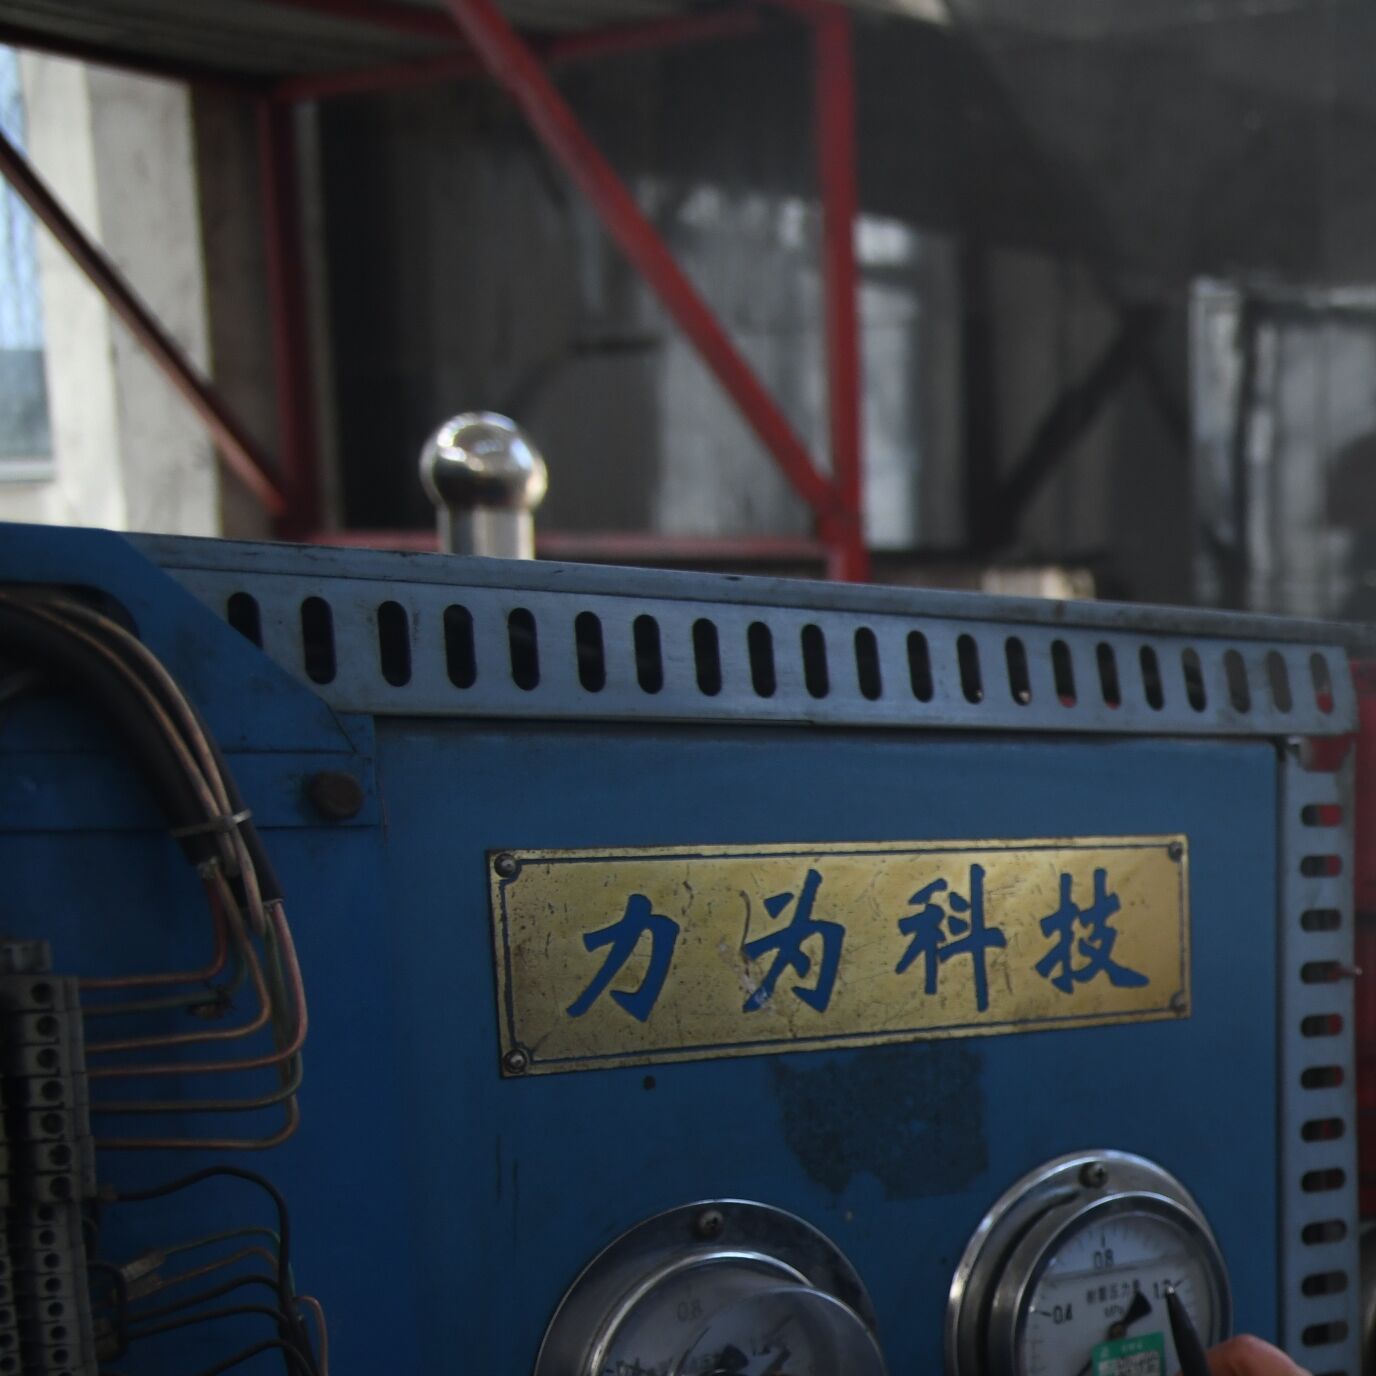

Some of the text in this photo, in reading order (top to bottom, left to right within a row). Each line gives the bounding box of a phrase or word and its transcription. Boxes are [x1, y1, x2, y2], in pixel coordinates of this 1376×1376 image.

[566, 863, 1150, 1022] 力为科技
[1093, 1249, 1114, 1269] 0.8
[1053, 1306, 1073, 1324] 0.4
